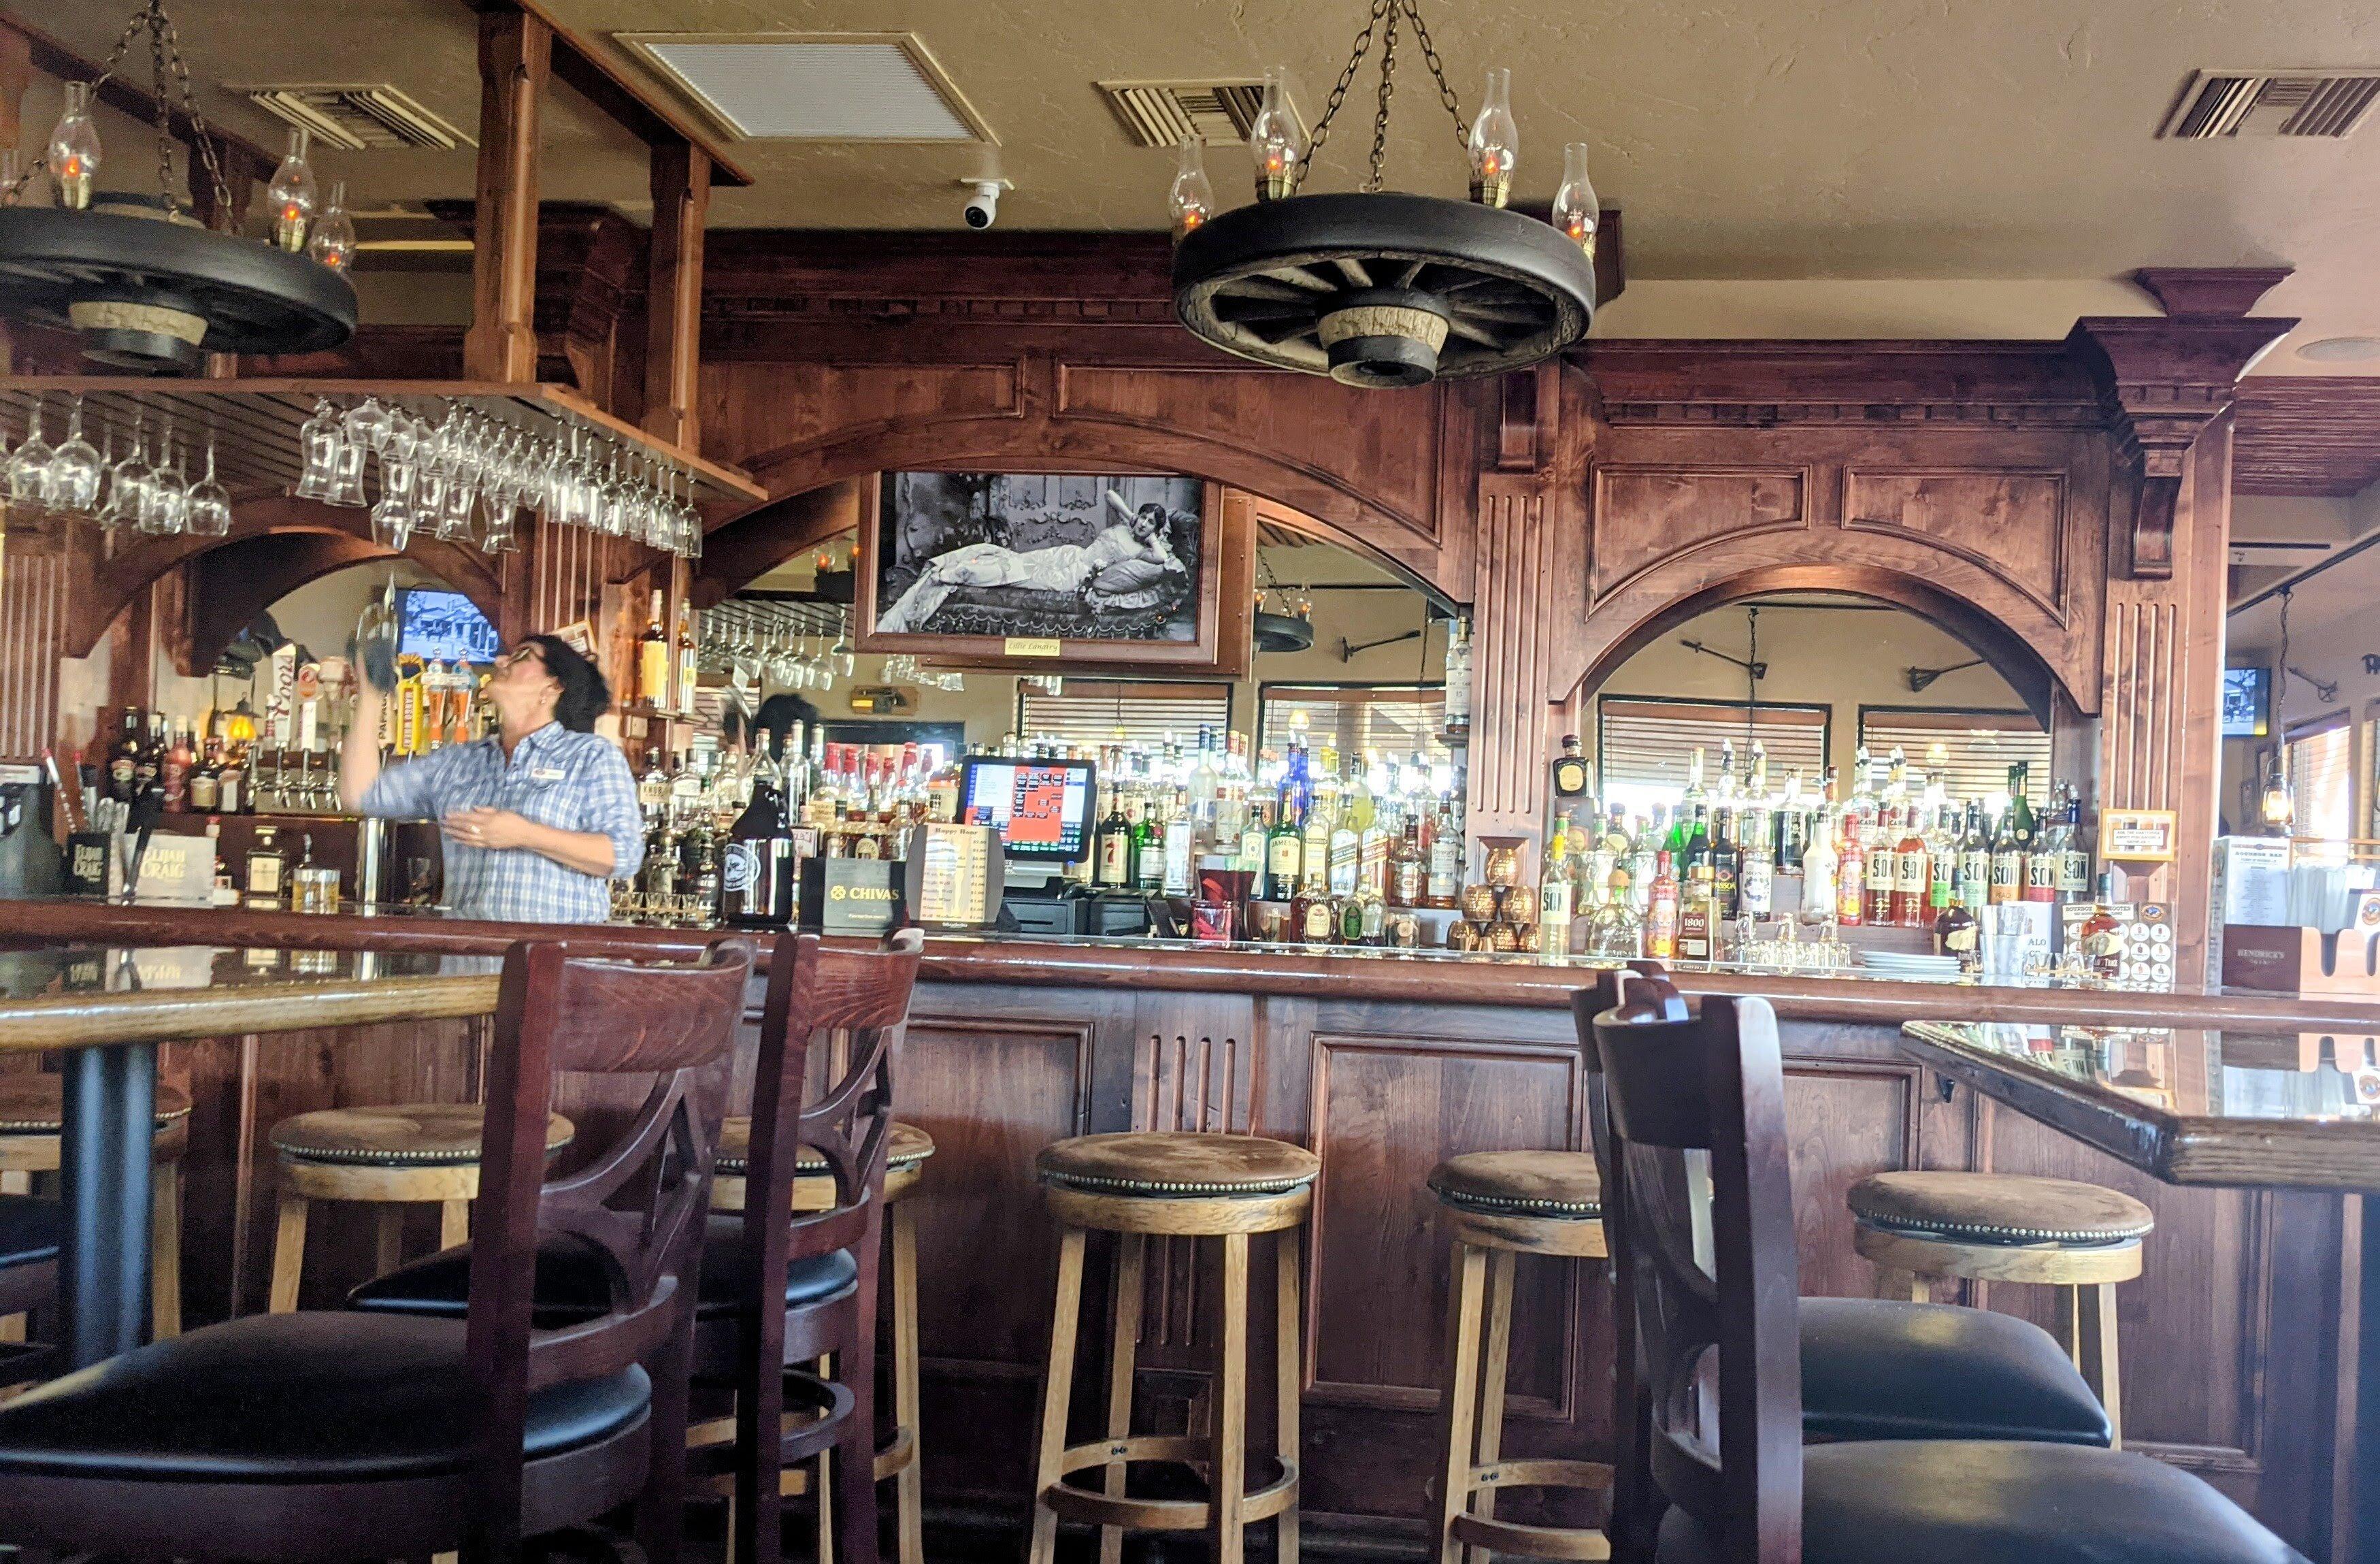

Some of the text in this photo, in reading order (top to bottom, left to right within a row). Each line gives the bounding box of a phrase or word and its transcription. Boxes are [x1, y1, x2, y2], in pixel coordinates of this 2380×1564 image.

[1028, 643, 1059, 653] Langtry
[1271, 839, 1300, 848] JAMESON
[75, 845, 103, 861] ELIJAH
[144, 847, 186, 862] ELIJAH
[1105, 841, 1119, 864] 7
[73, 859, 103, 877] CRAIG
[139, 860, 185, 879] CRAIG
[1872, 859, 1895, 878] SON
[2032, 858, 2054, 866] WESTRN
[2064, 860, 2086, 879] SON
[1964, 862, 1987, 881] SON
[1994, 866, 2017, 884] SON
[2030, 866, 2053, 885] SON
[849, 887, 899, 900] CHIVAS
[1684, 918, 1705, 928] 1800
[2237, 949, 2285, 959] HENDRICK'S
